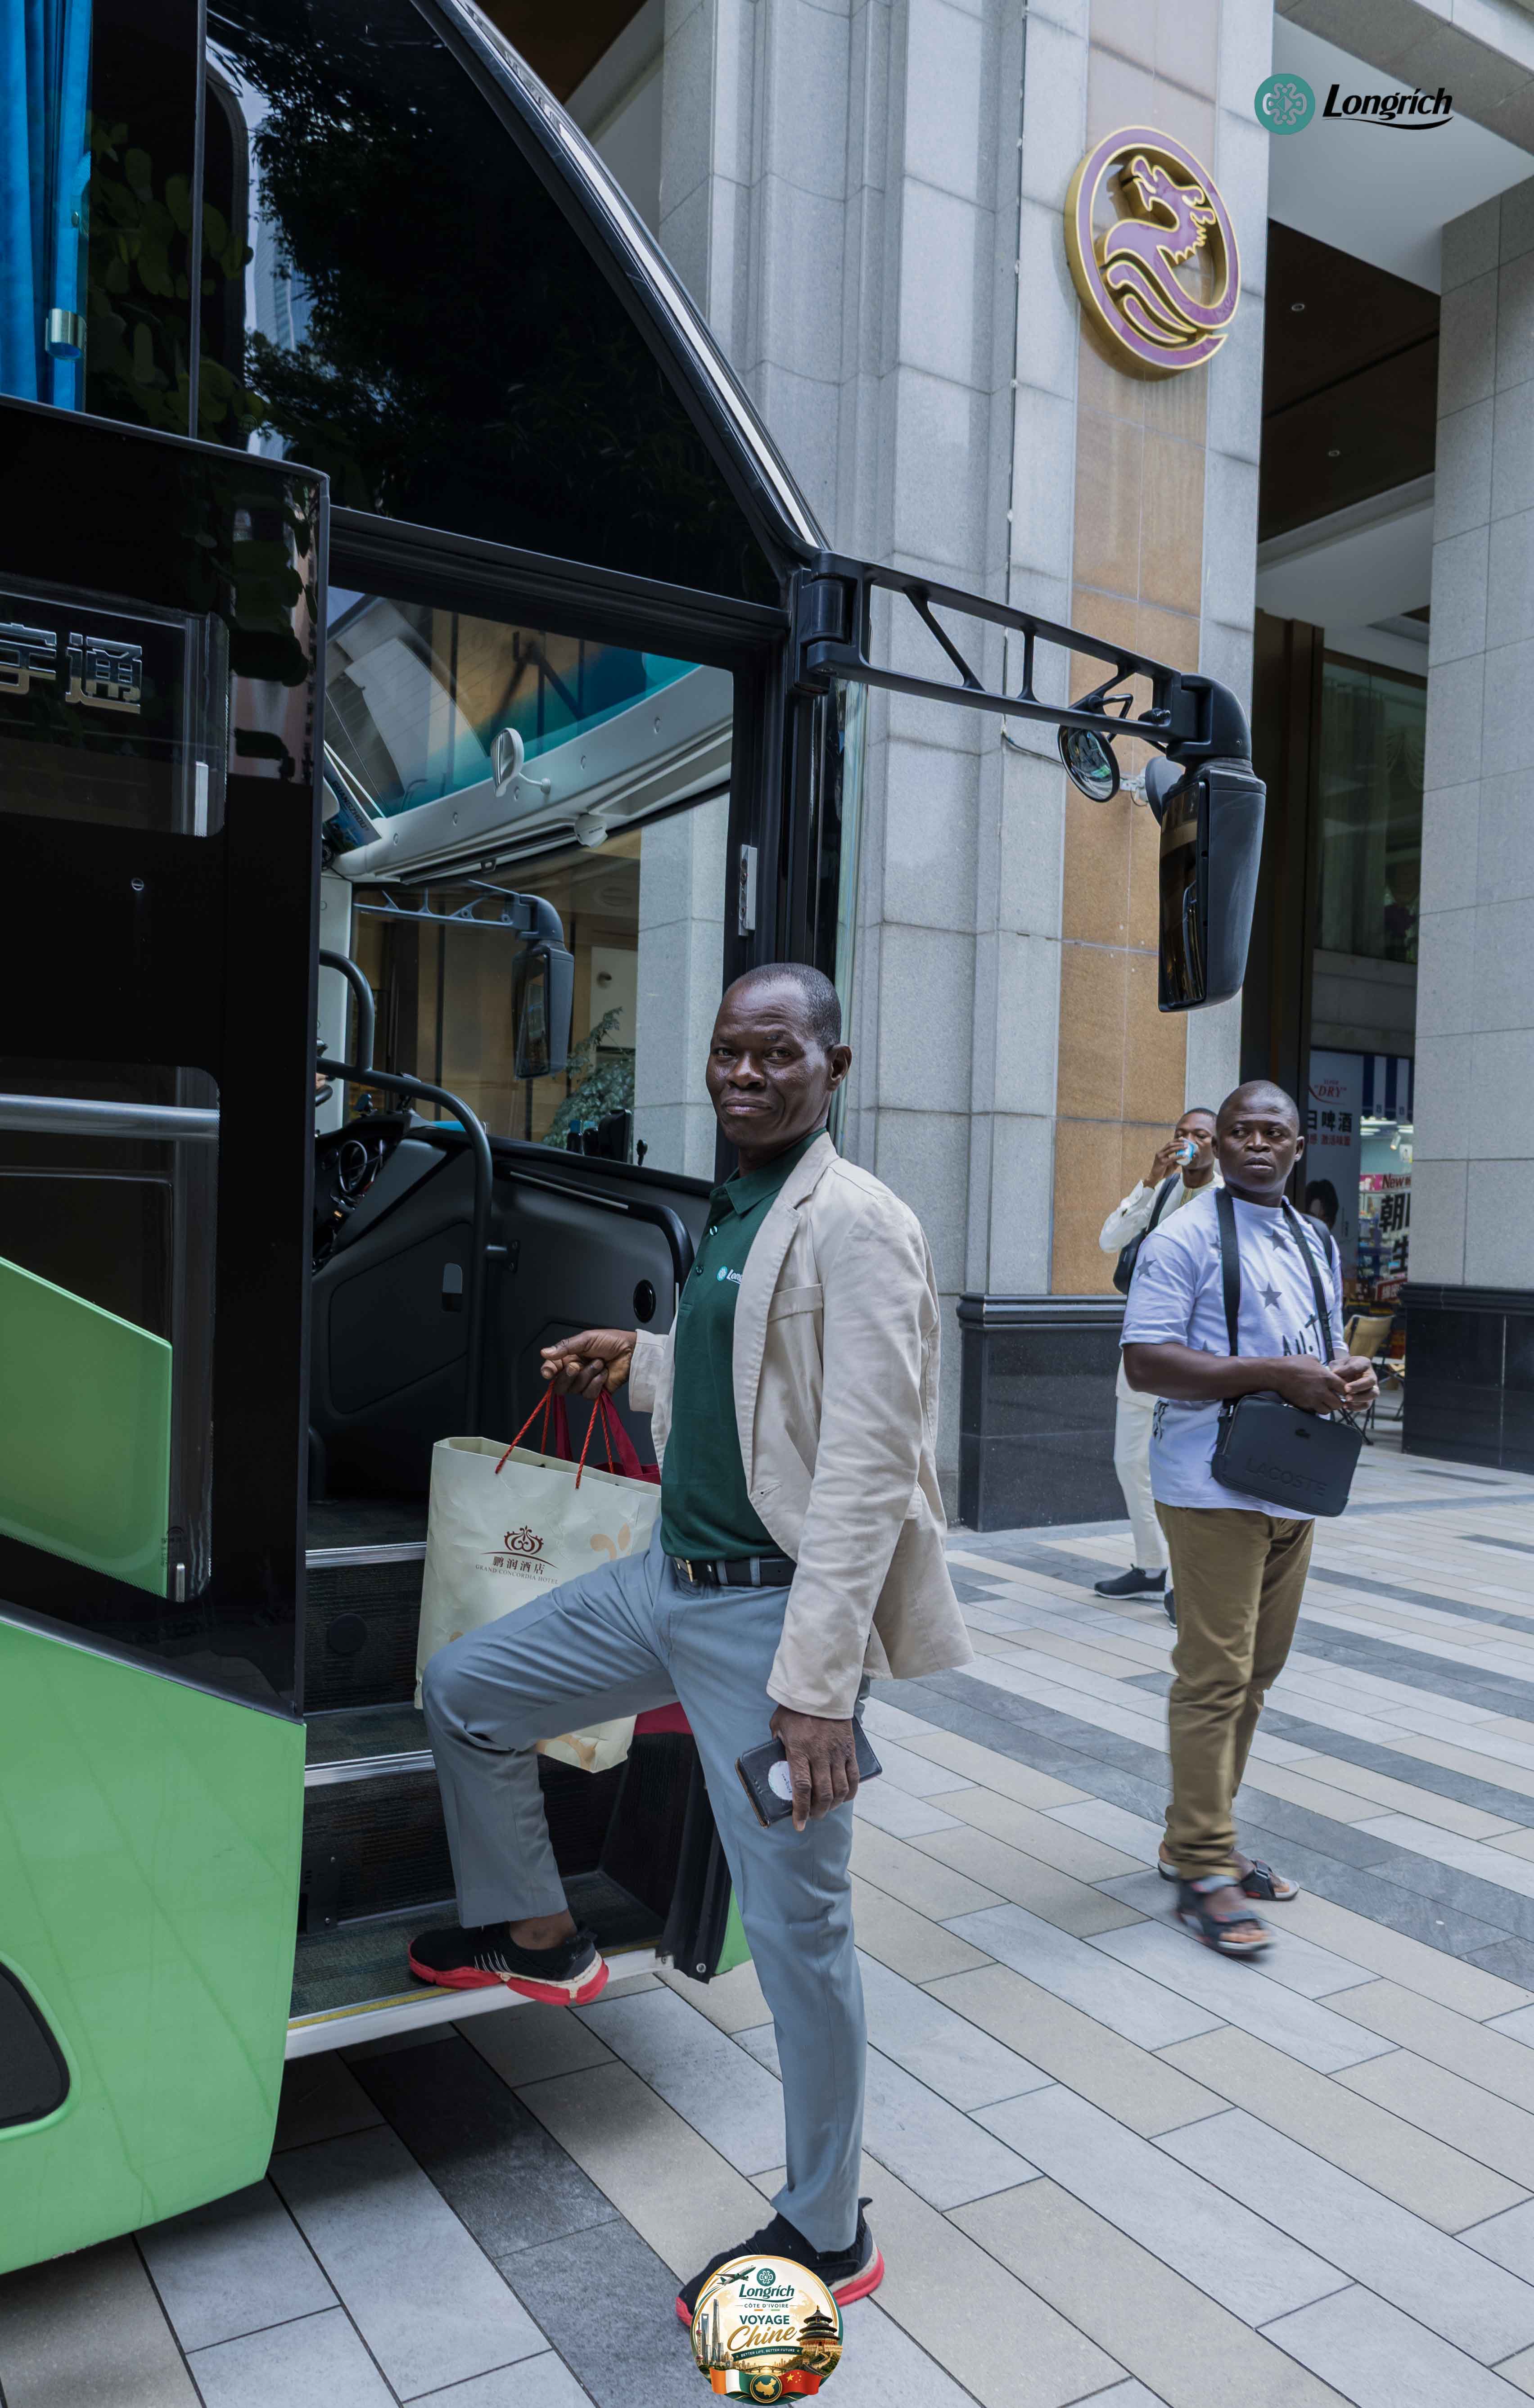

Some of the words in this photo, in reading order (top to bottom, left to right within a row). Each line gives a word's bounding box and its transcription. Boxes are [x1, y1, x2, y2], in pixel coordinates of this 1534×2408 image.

[1382, 1173, 1404, 1190] New
[1245, 1457, 1328, 1497] LACOSTE
[475, 1564, 497, 1574] GRAND
[499, 1569, 536, 1581] CONCORDIA
[538, 1576, 559, 1585] HOTEL
[492, 1556, 545, 1575] 鹏润酒店
